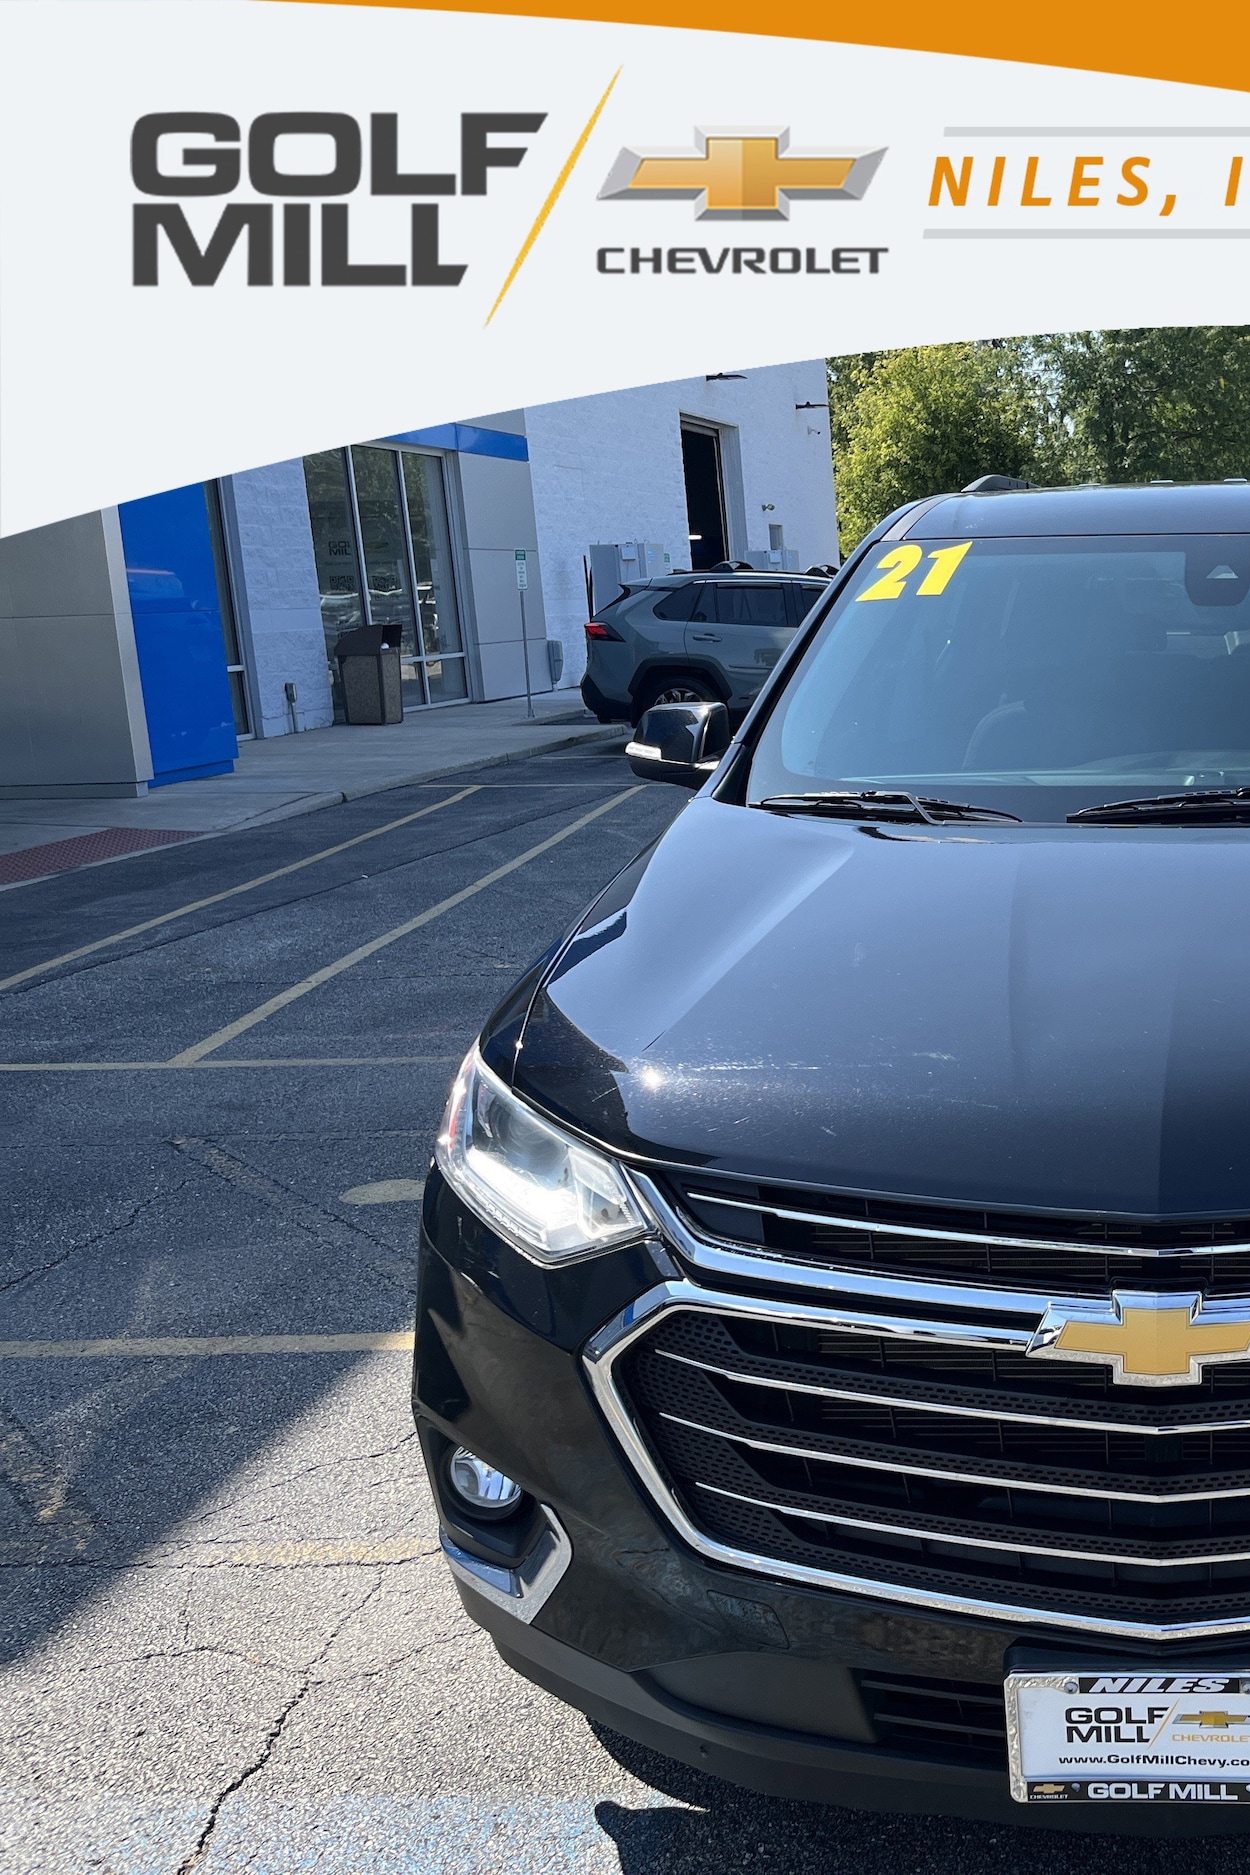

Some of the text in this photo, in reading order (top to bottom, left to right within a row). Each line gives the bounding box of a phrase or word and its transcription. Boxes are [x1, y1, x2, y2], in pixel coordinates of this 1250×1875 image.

[855, 541, 973, 602] 21
[1089, 1678, 1230, 1693] NILES
[1065, 1707, 1169, 1724] GOLF
[1066, 1726, 1150, 1743] MILL
[1088, 1783, 1238, 1800] GOLF MILL
